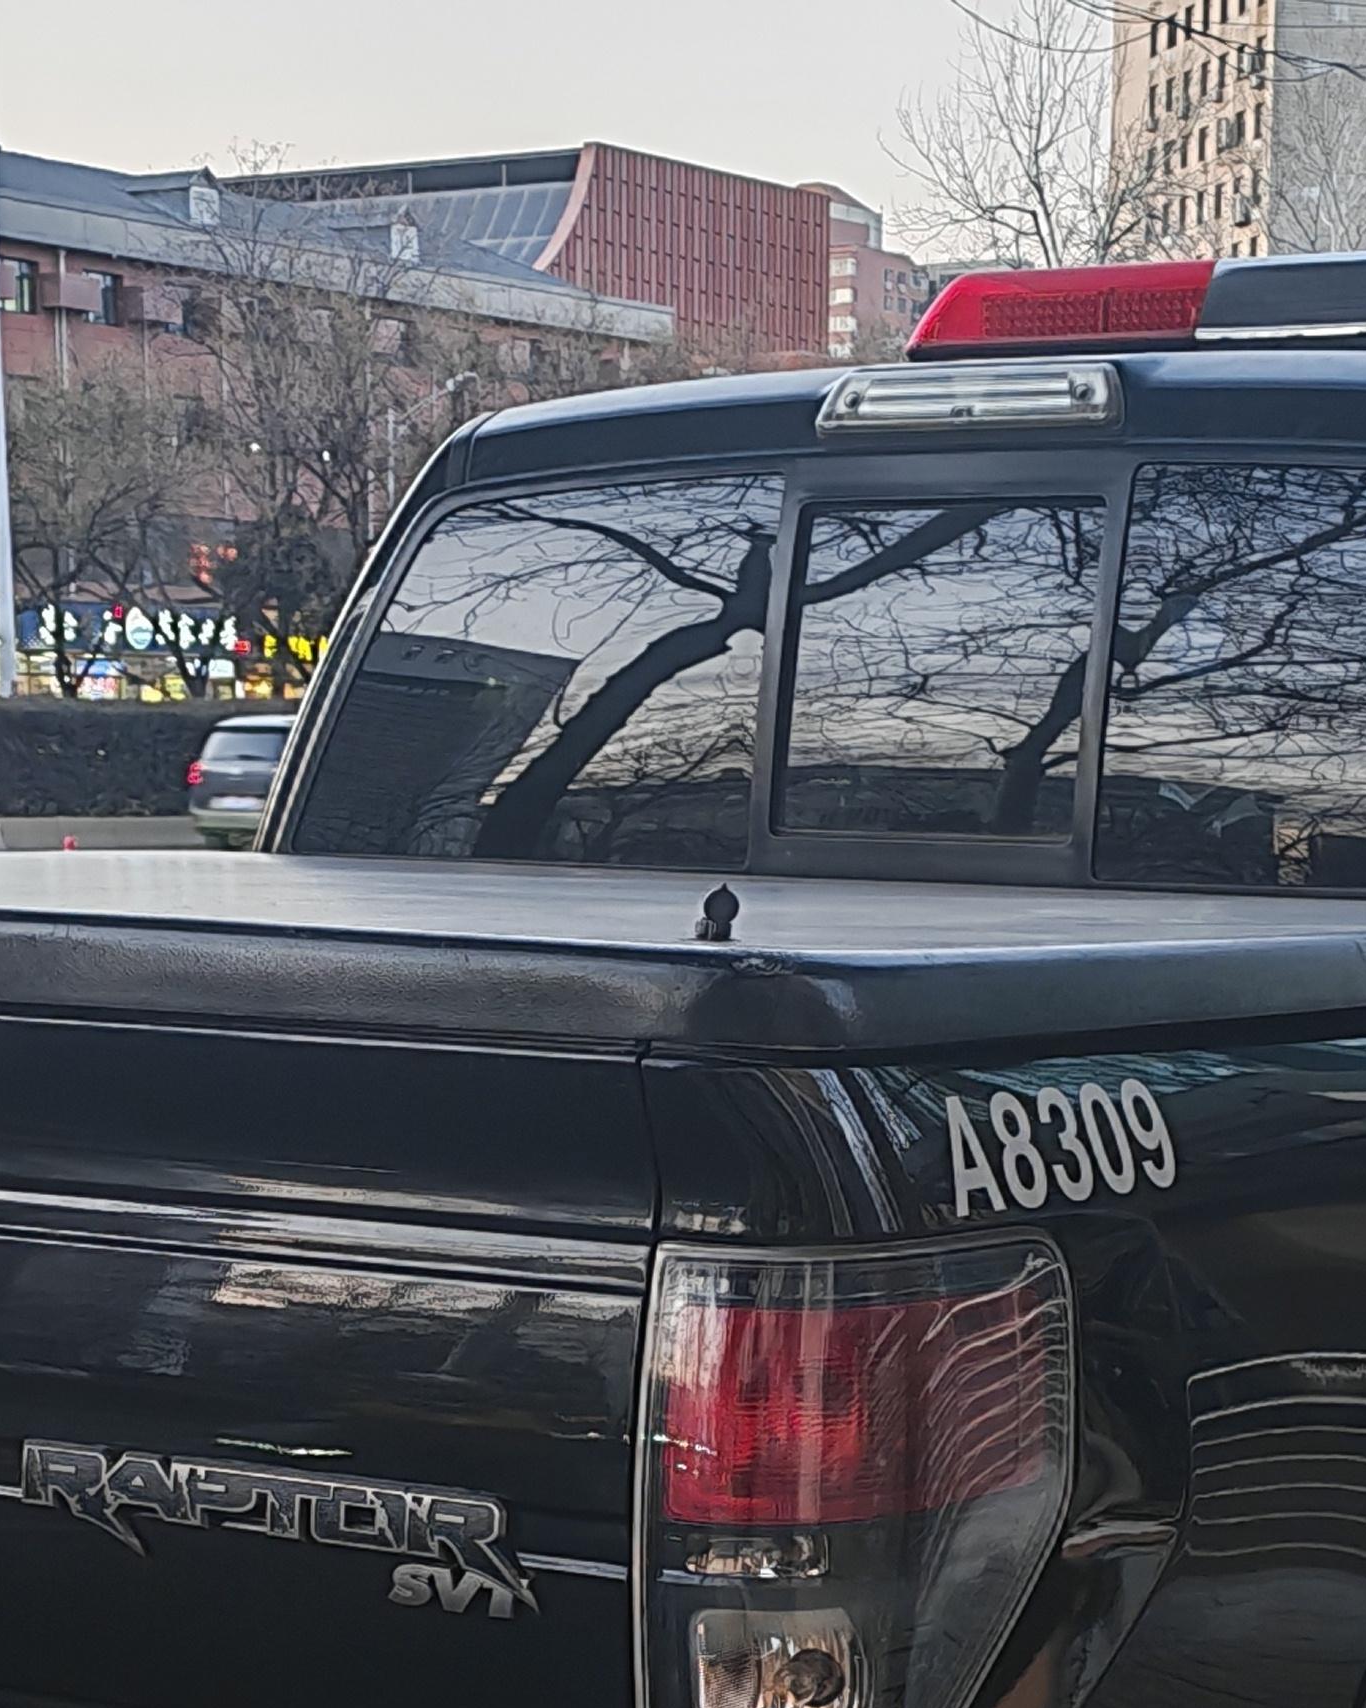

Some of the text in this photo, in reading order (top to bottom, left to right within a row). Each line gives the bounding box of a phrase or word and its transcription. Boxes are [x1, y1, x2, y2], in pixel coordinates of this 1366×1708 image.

[945, 1078, 1176, 1218] A8309
[21, 1438, 539, 1613] RAPTOR
[388, 1563, 521, 1619] SVT
